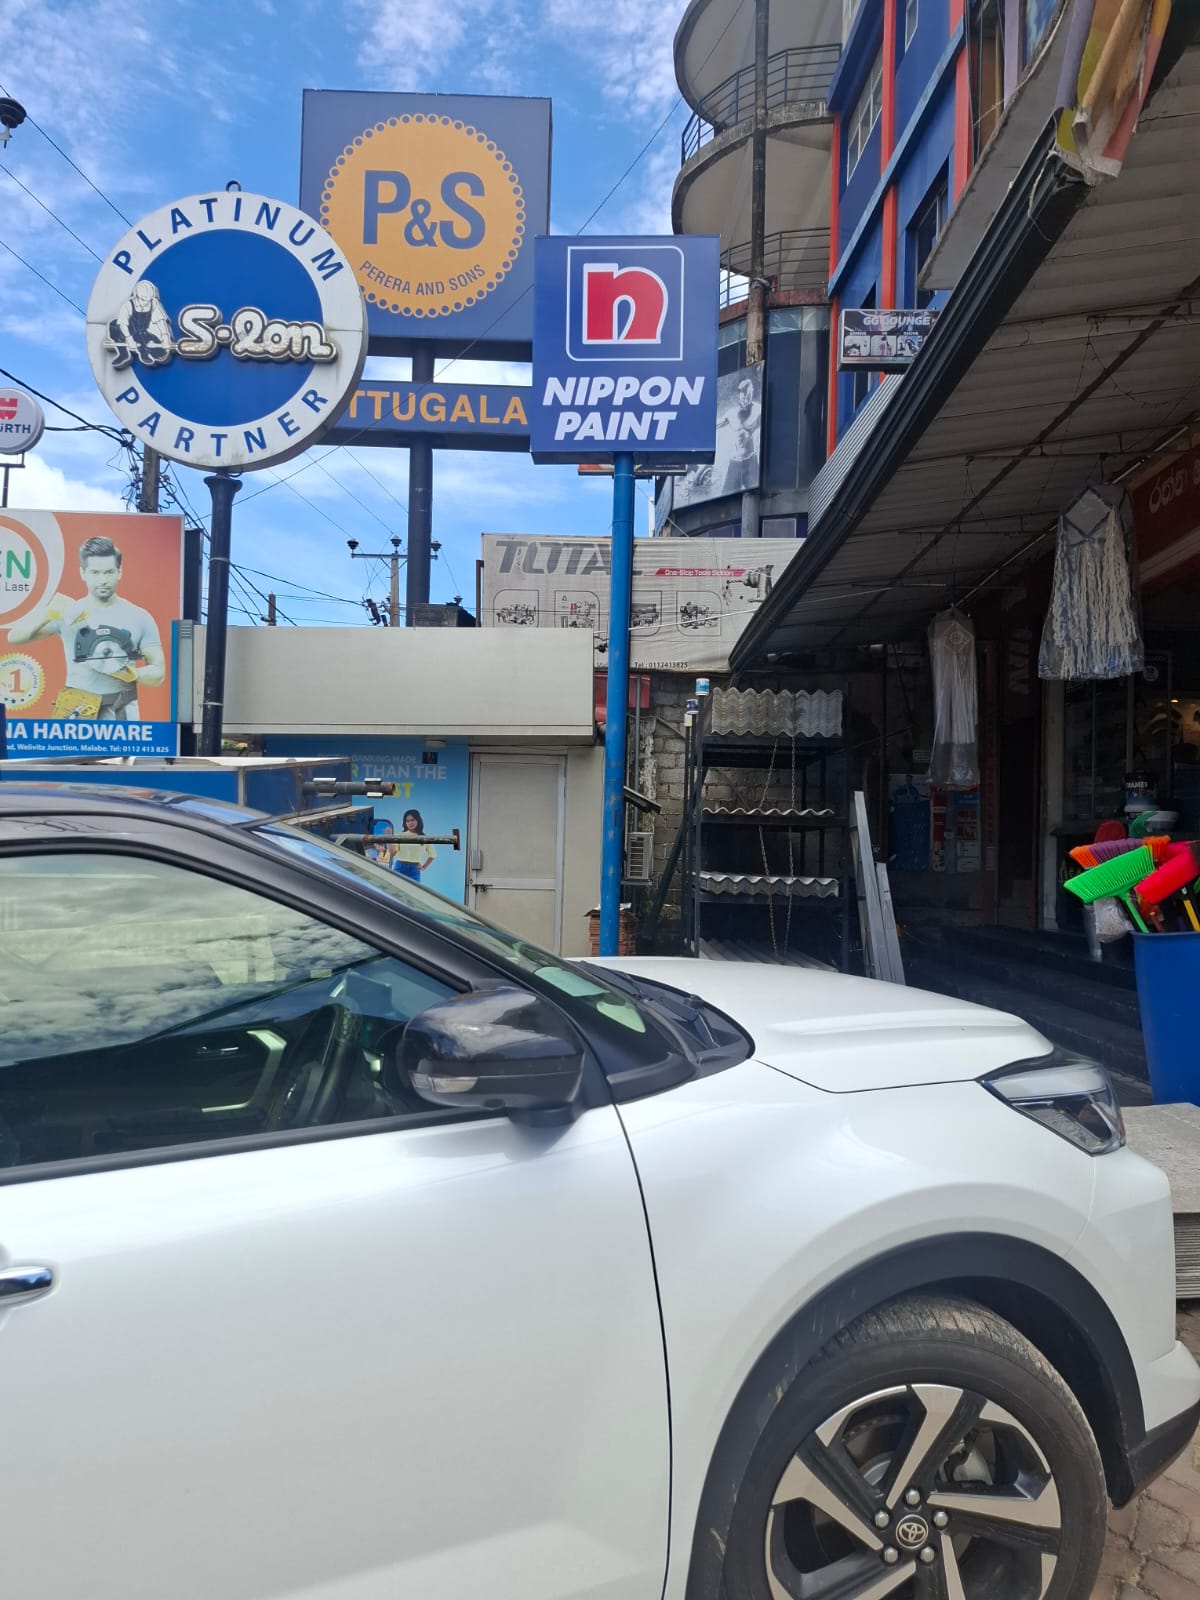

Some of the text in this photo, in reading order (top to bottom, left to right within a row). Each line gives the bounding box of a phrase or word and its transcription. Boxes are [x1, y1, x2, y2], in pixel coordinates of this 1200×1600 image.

[362, 169, 487, 250] P&S
[112, 197, 343, 281] PLATINUM
[359, 260, 486, 296] PERERA AND SONS
[542, 376, 705, 406] NIPPON
[115, 386, 329, 457] PARTNER
[350, 390, 528, 425] TTUGALA
[554, 411, 677, 441] PAINT
[0, 550, 31, 580] N
[5, 581, 30, 592] Last
[17, 743, 46, 751] Welivita
[33, 723, 153, 742] HARDWARE
[361, 764, 410, 779] THAN
[413, 765, 448, 780] THE
